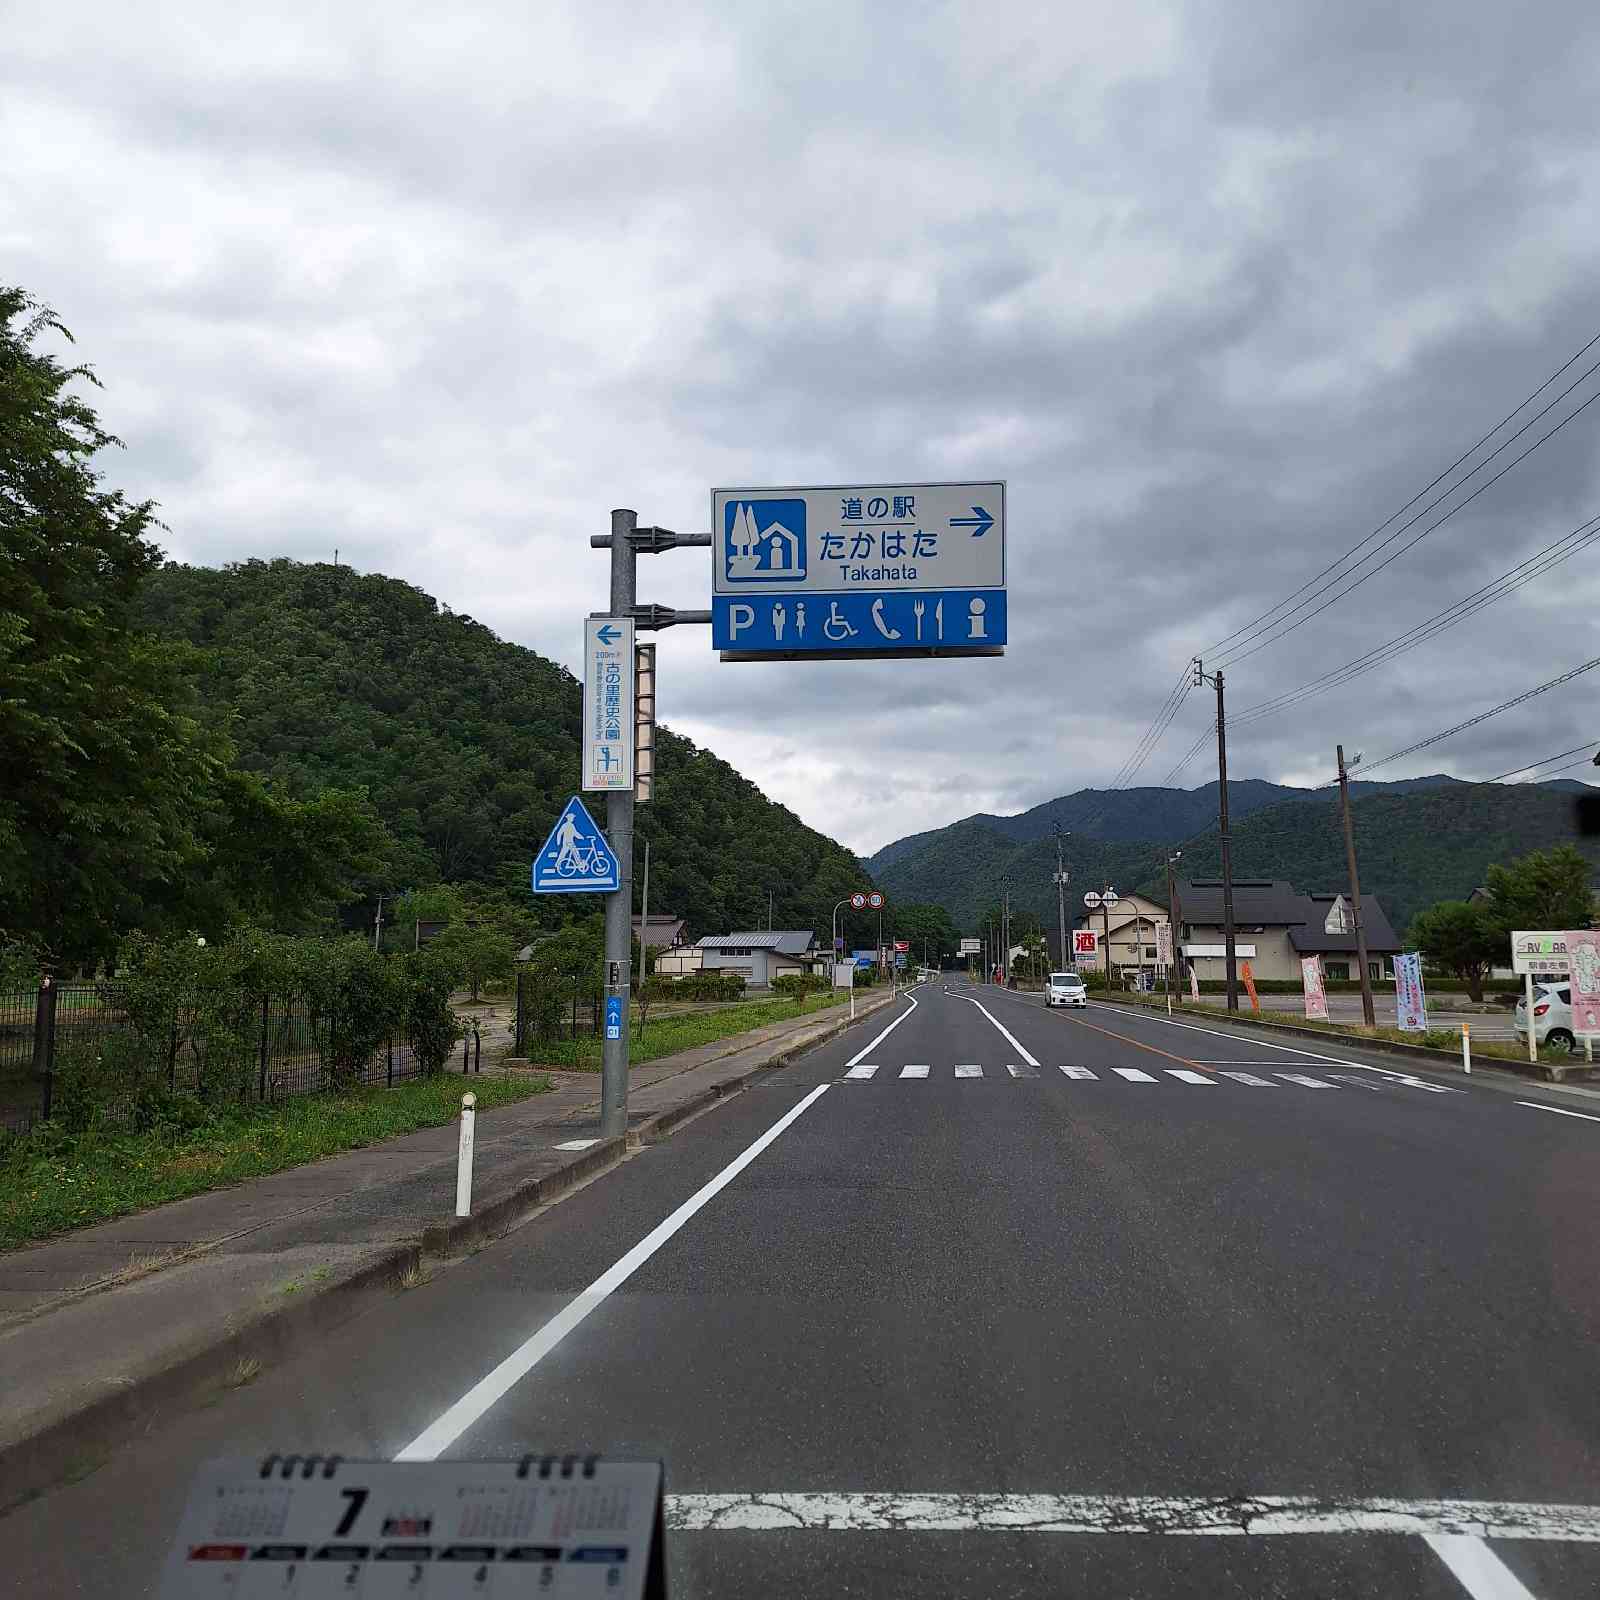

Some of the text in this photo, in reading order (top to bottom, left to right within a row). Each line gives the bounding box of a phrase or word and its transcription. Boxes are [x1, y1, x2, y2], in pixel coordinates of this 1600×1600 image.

[841, 496, 916, 520] 道の駅
[820, 529, 938, 560] たかはた
[840, 565, 917, 580] Takahata
[729, 604, 755, 640] P
[1076, 933, 1095, 951] 酒
[334, 1488, 369, 1537] 7
[286, 1563, 297, 1583] 1
[345, 1563, 361, 1585] 2
[408, 1563, 423, 1585] 3
